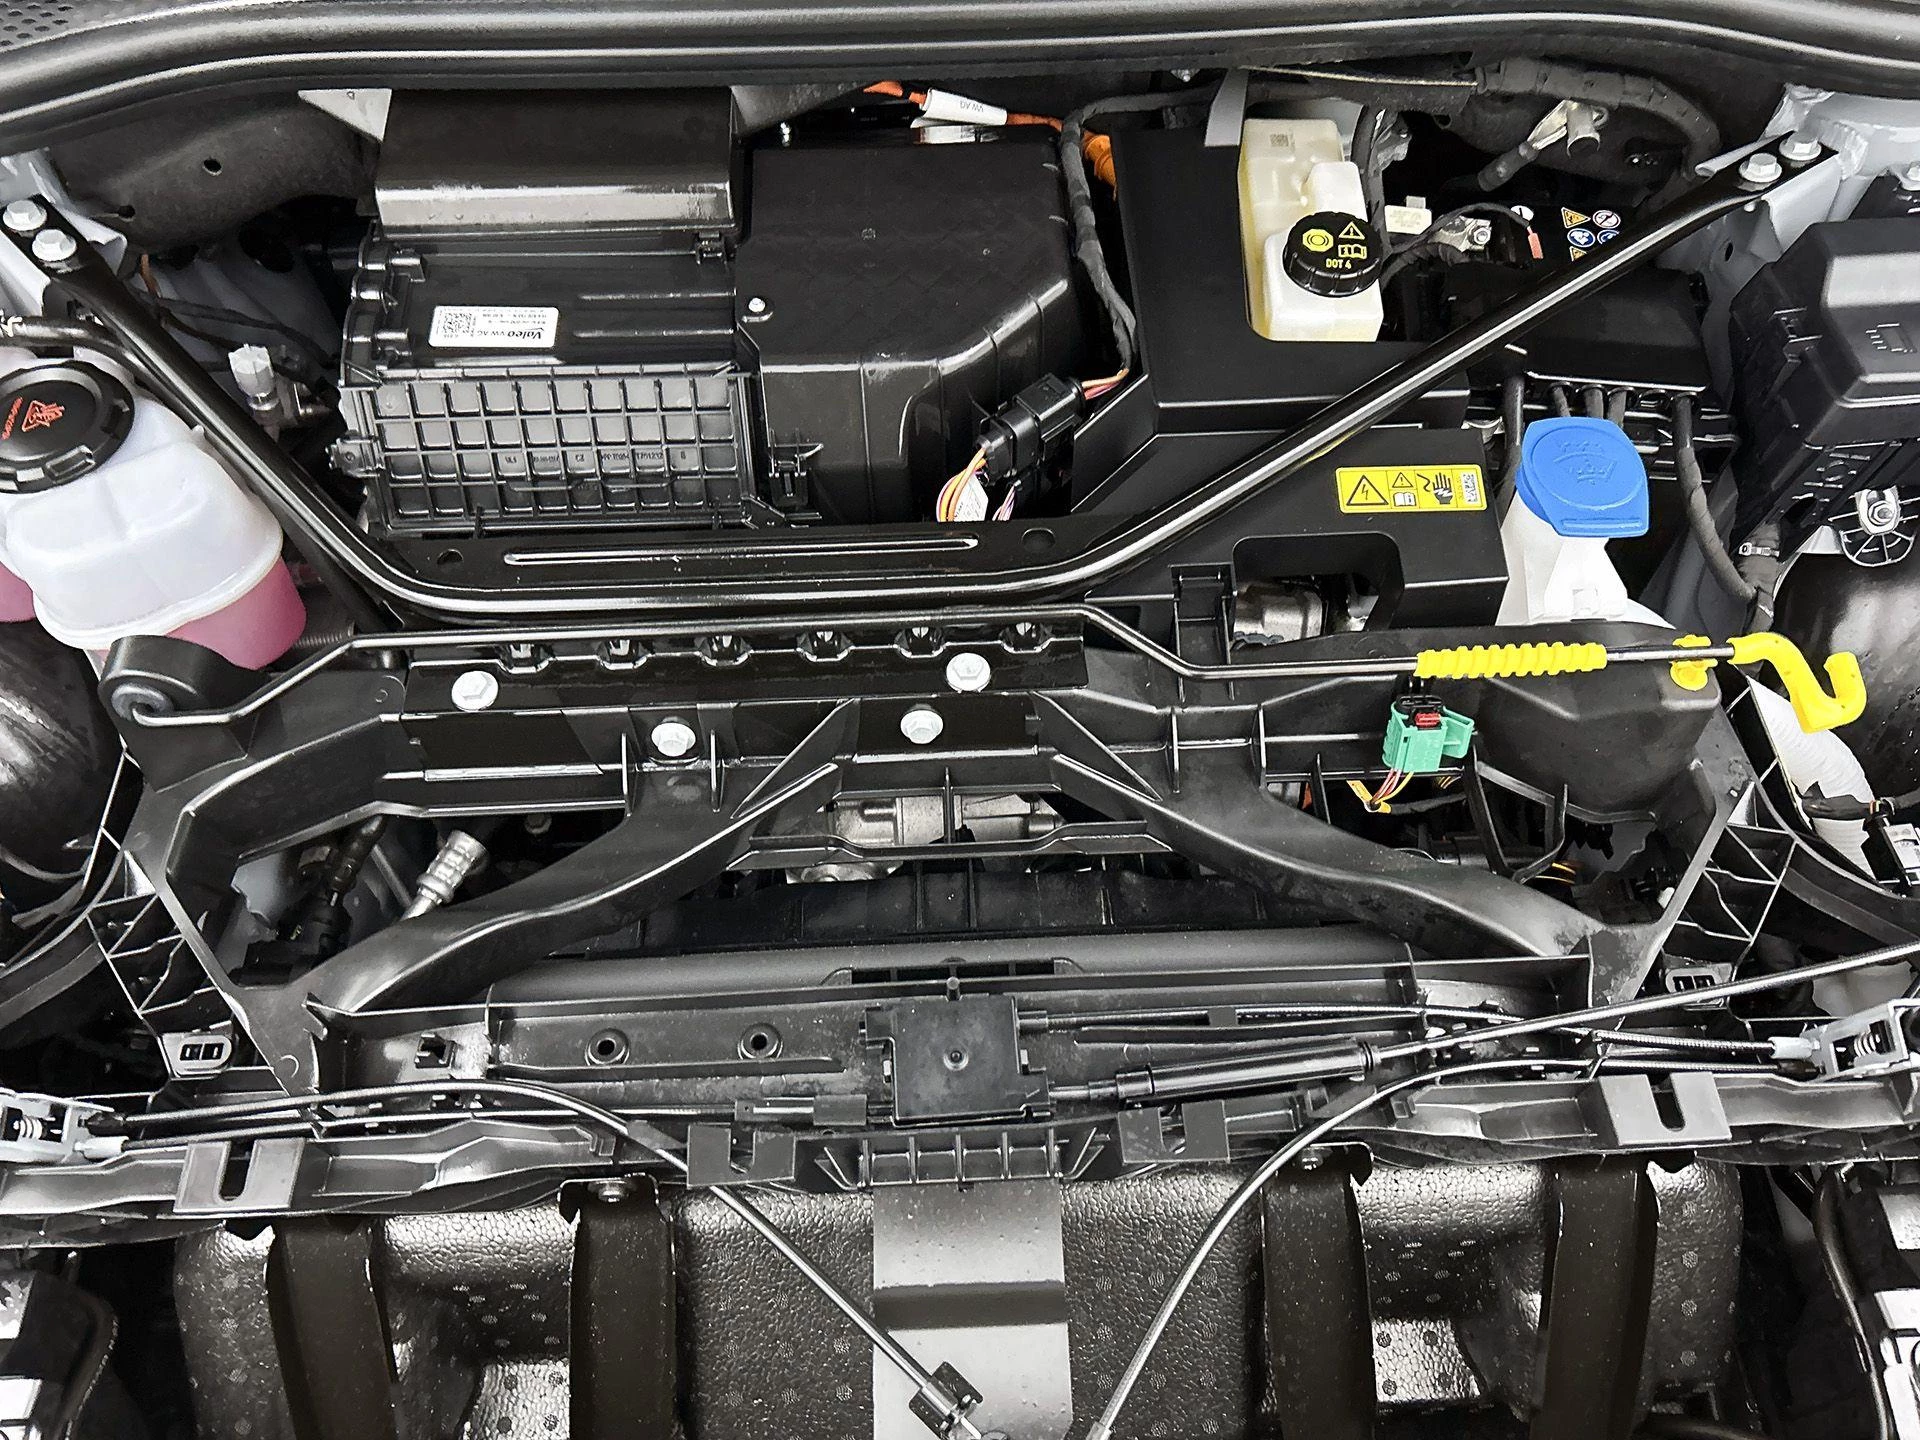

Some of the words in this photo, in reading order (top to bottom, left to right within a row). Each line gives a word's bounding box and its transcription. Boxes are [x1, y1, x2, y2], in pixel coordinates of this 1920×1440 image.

[1326, 258, 1343, 268] DOT
[1345, 260, 1352, 269] 4
[507, 331, 541, 339] Valeo
